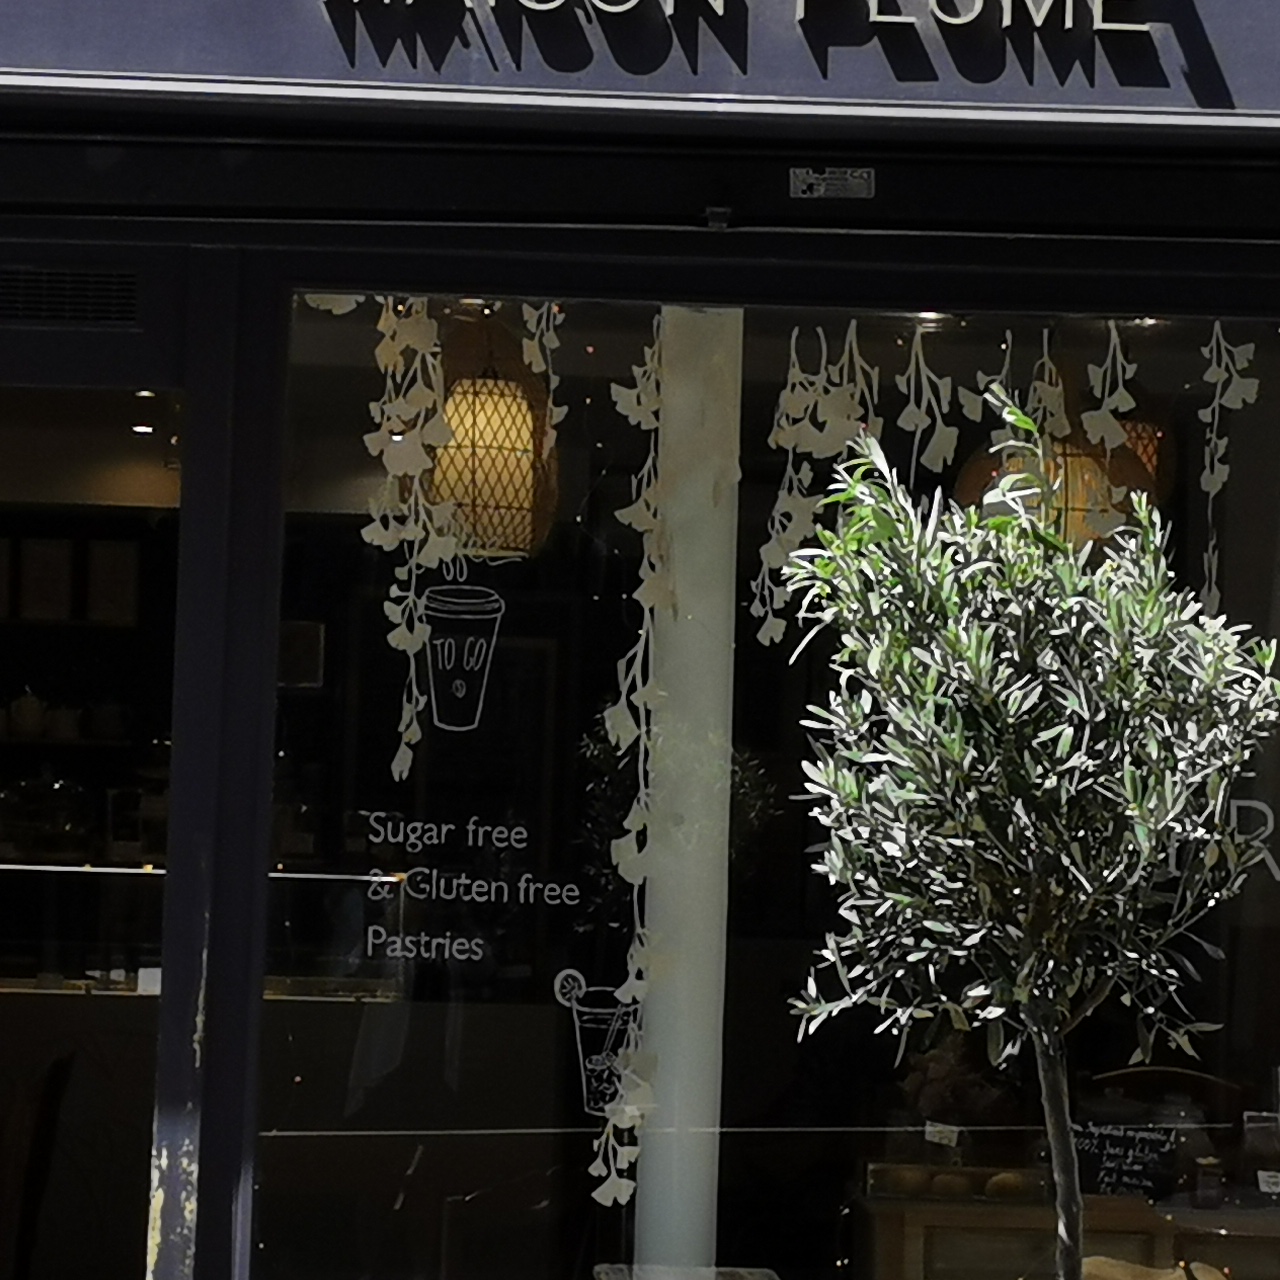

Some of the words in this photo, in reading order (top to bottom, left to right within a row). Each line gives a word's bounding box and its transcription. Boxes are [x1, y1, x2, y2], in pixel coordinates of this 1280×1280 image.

[433, 639, 455, 670] TO
[464, 637, 486, 671] GO
[368, 812, 455, 853] Sugar
[467, 817, 528, 849] free
[367, 869, 394, 900] &
[405, 867, 508, 903] Gluten
[517, 873, 580, 905] free
[366, 925, 484, 960] Pastries
